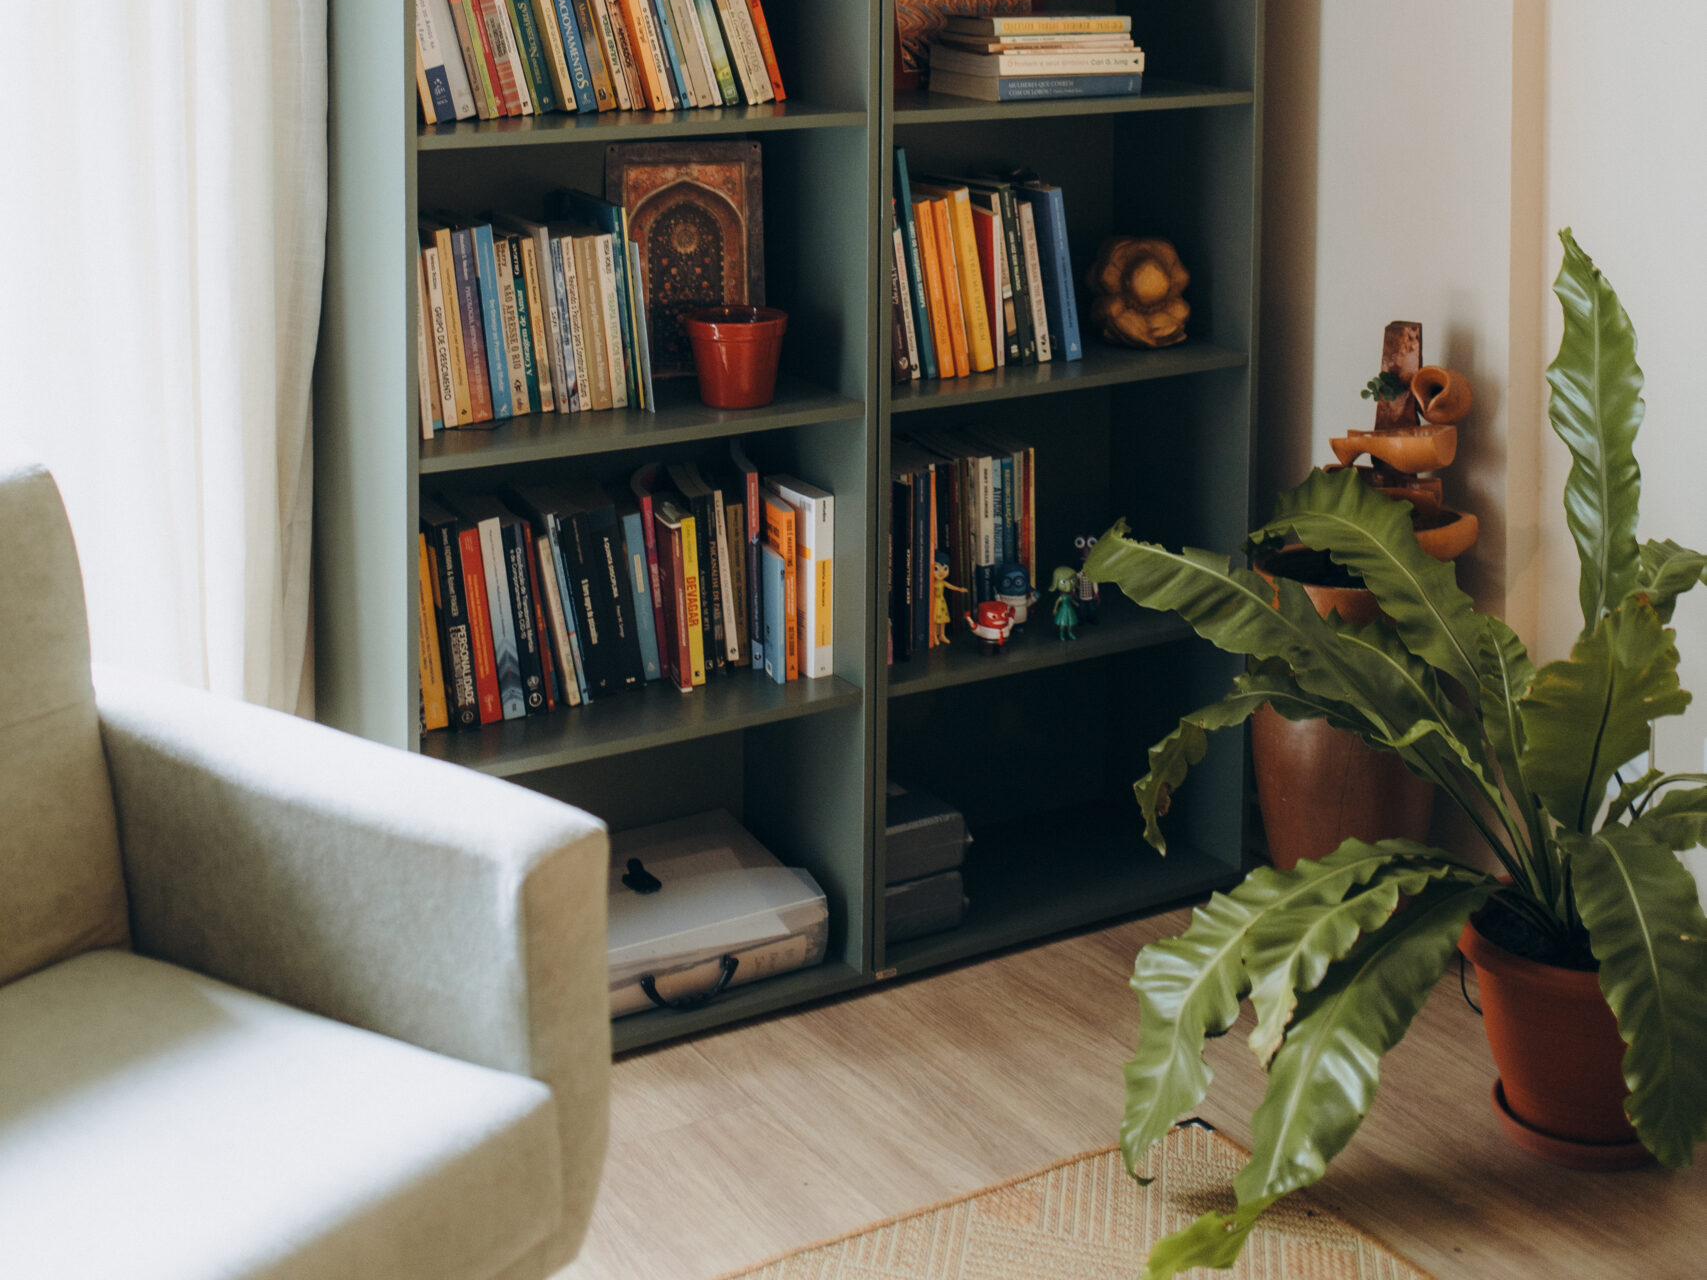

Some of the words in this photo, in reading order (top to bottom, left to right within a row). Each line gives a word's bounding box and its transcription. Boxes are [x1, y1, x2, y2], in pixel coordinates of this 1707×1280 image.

[653, 52, 663, 73] crise
[434, 306, 443, 332] GRUPO
[516, 288, 524, 312] Amar
[505, 304, 518, 344] APRESSE
[520, 328, 531, 367] Coragem
[438, 346, 451, 400] CRESCIMENTO
[686, 575, 699, 626] DEVAGAR
[456, 624, 474, 704] PERSONALIDADE
